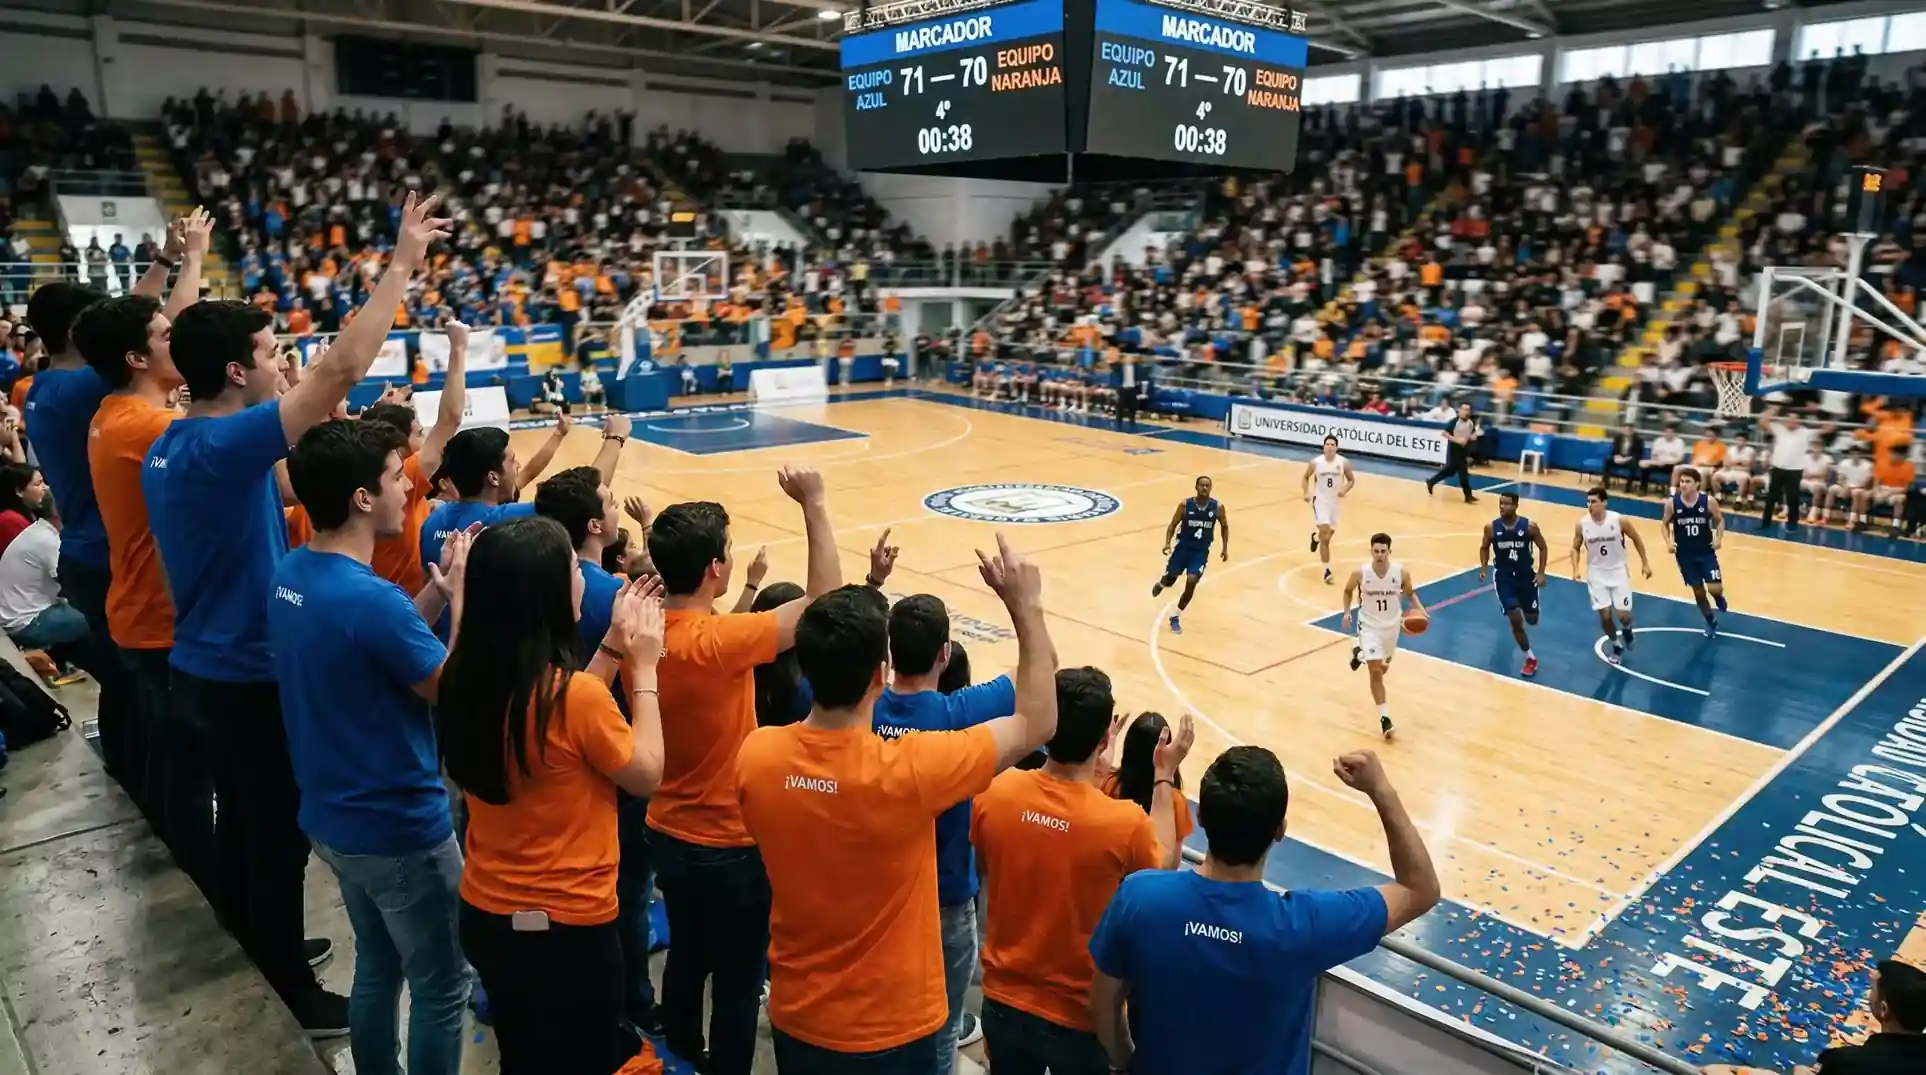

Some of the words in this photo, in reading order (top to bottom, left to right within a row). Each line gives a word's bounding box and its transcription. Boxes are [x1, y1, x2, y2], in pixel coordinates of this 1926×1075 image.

[895, 15, 992, 53] MARCADOR
[1162, 15, 1256, 53] MARCADOR
[997, 43, 1054, 69] EQUIPO
[1101, 42, 1155, 67] EQUIPO
[849, 69, 892, 91] EQUIPO
[901, 65, 924, 96] 71
[959, 56, 988, 88] 70
[991, 67, 1063, 92] NARANJA
[1108, 68, 1146, 90] AZUL
[1164, 55, 1189, 87] 71
[1222, 65, 1247, 97] 70
[1255, 69, 1297, 91] EQUIPO
[856, 93, 887, 111] AZUL
[1247, 89, 1300, 112] NARANJA
[917, 124, 972, 155] 00:38
[1174, 124, 1227, 155] 00:38
[1255, 416, 1326, 436] UNIVERSIDAD
[1329, 426, 1383, 445] CATÓLICA
[1386, 433, 1409, 448] DEL
[1412, 437, 1441, 452] ESTE
[1327, 477, 1333, 488] 8
[1194, 528, 1203, 539] 4
[1685, 525, 1699, 537] 10
[1600, 545, 1608, 556] 6
[1376, 599, 1388, 611] 11
[1623, 597, 1629, 606] 6
[784, 774, 838, 794] ¡VAMOS!
[1020, 809, 1070, 833] ¡VAMOS!
[1184, 920, 1243, 944] ¡VAMOS!
[1650, 889, 1822, 1011] ESTE
